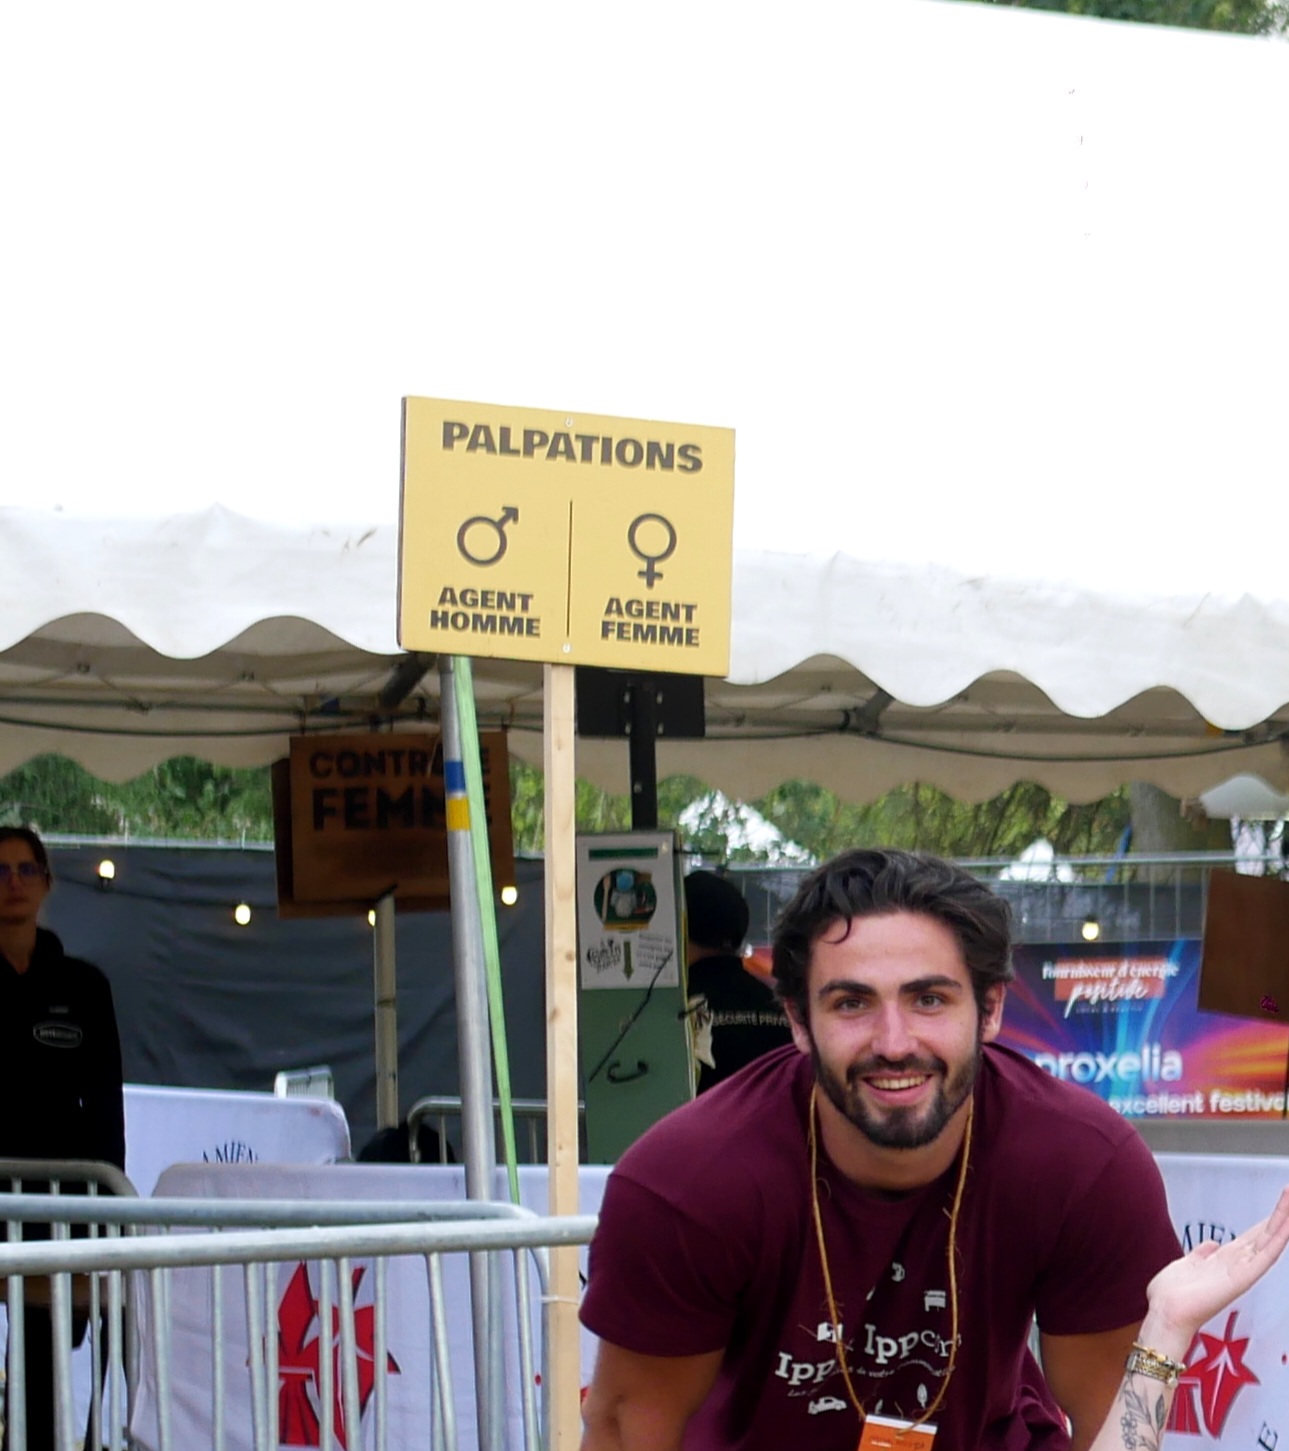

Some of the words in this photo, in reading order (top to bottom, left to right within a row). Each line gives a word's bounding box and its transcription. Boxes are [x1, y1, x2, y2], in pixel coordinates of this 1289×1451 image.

[441, 420, 704, 475] PALPATIONS
[438, 586, 535, 614] AGENT
[604, 596, 699, 624] AGENT
[429, 610, 542, 638] HOMME
[600, 620, 701, 648] FEMME
[312, 784, 493, 832] FEMM
[775, 1351, 837, 1387] Ipp
